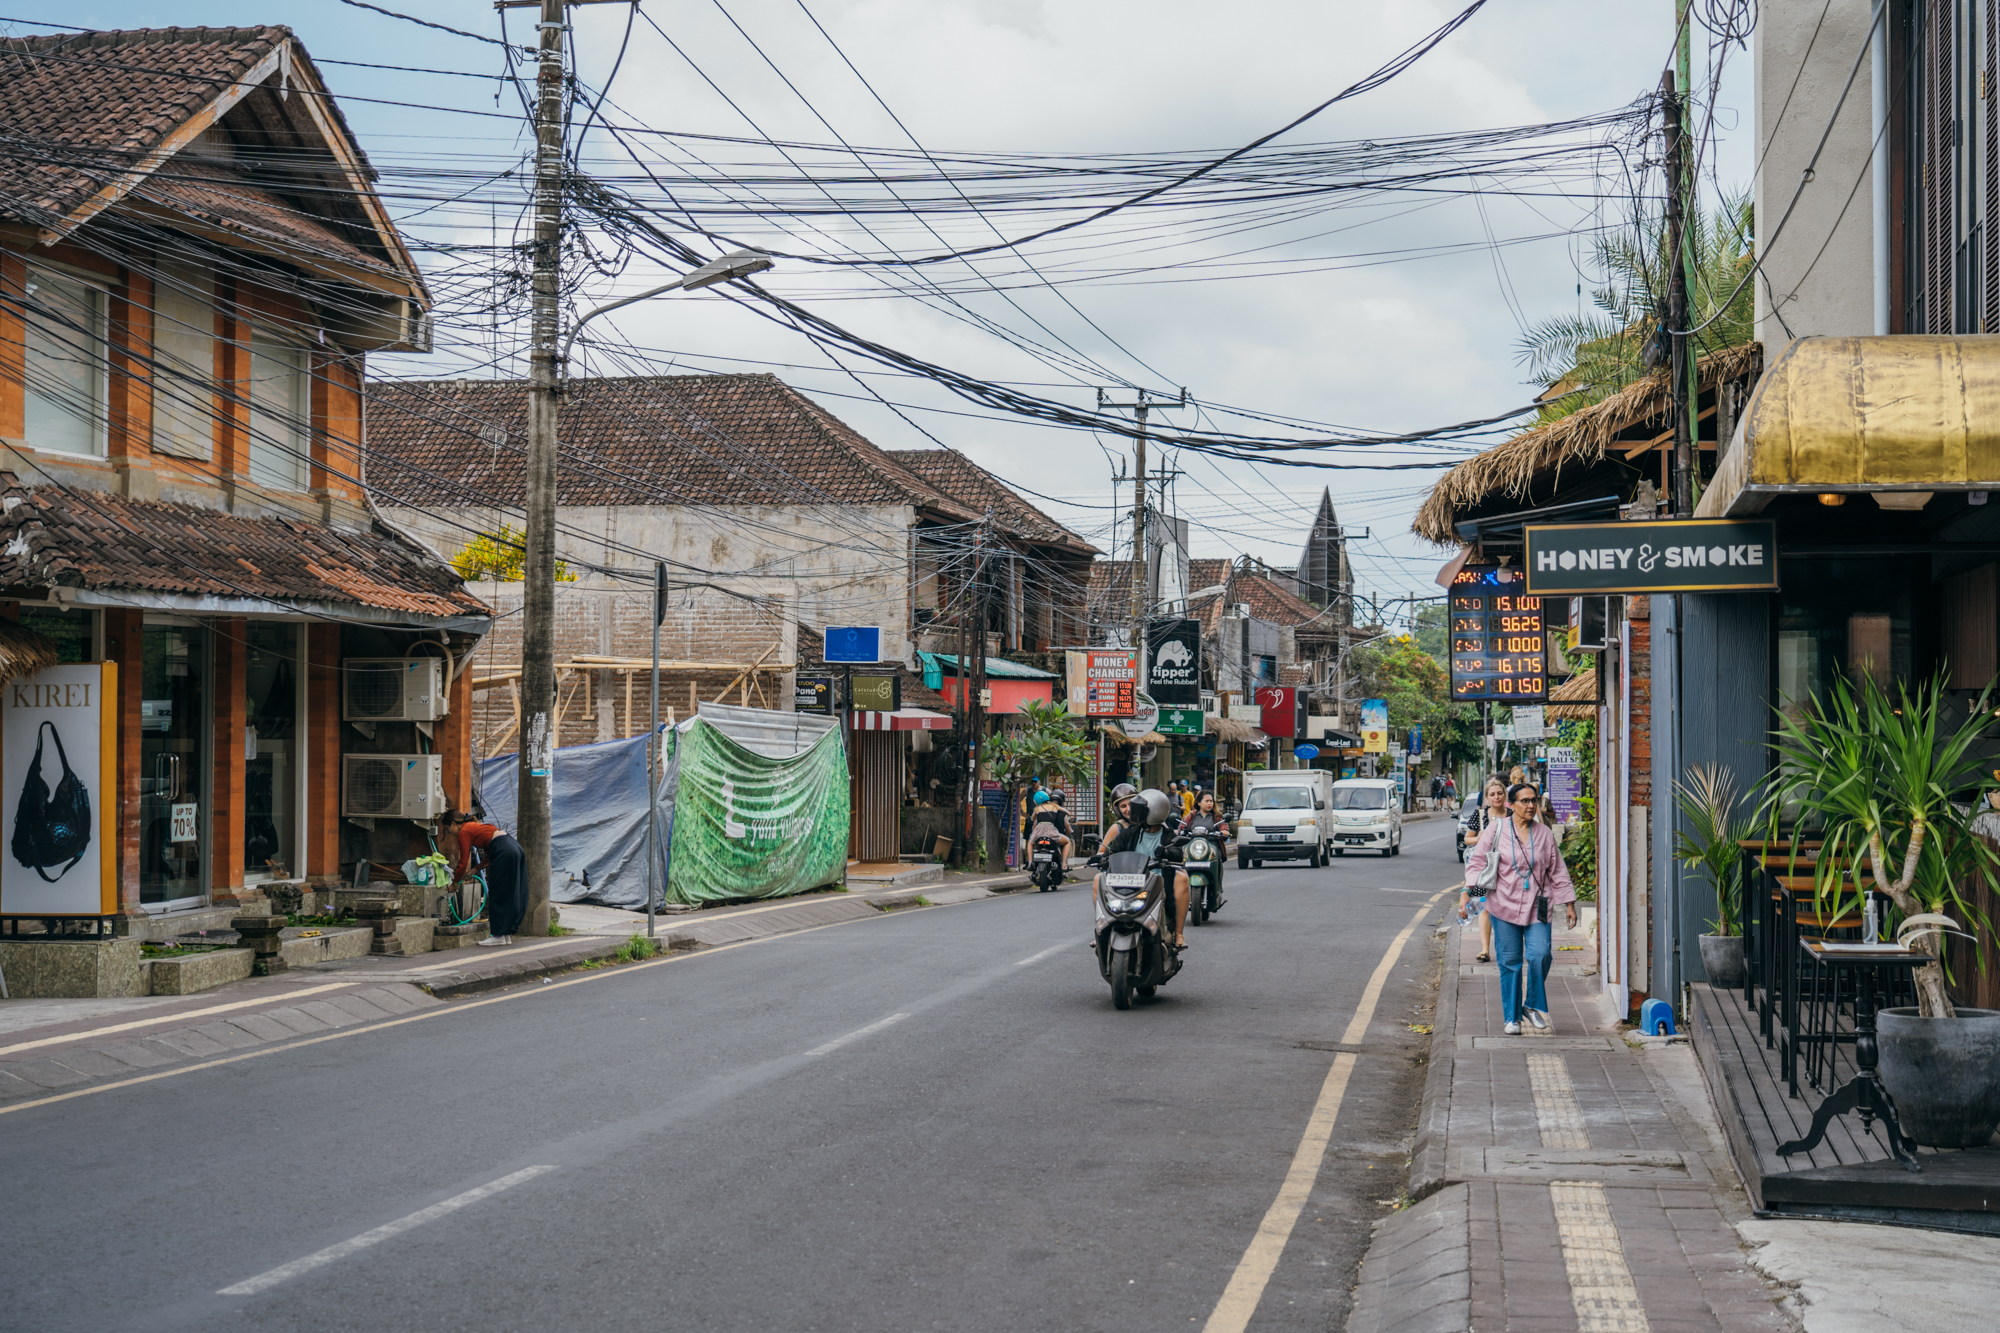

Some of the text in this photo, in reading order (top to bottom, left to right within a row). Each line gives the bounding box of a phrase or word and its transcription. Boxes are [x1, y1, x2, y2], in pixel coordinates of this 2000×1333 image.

[1537, 543, 1763, 573] HONEY & SMOKE
[1094, 657, 1128, 667] MONEY
[1088, 668, 1134, 678] CHANGER
[12, 683, 91, 708] KIREI
[176, 807, 192, 816] UP TO
[174, 817, 194, 837] 70%
